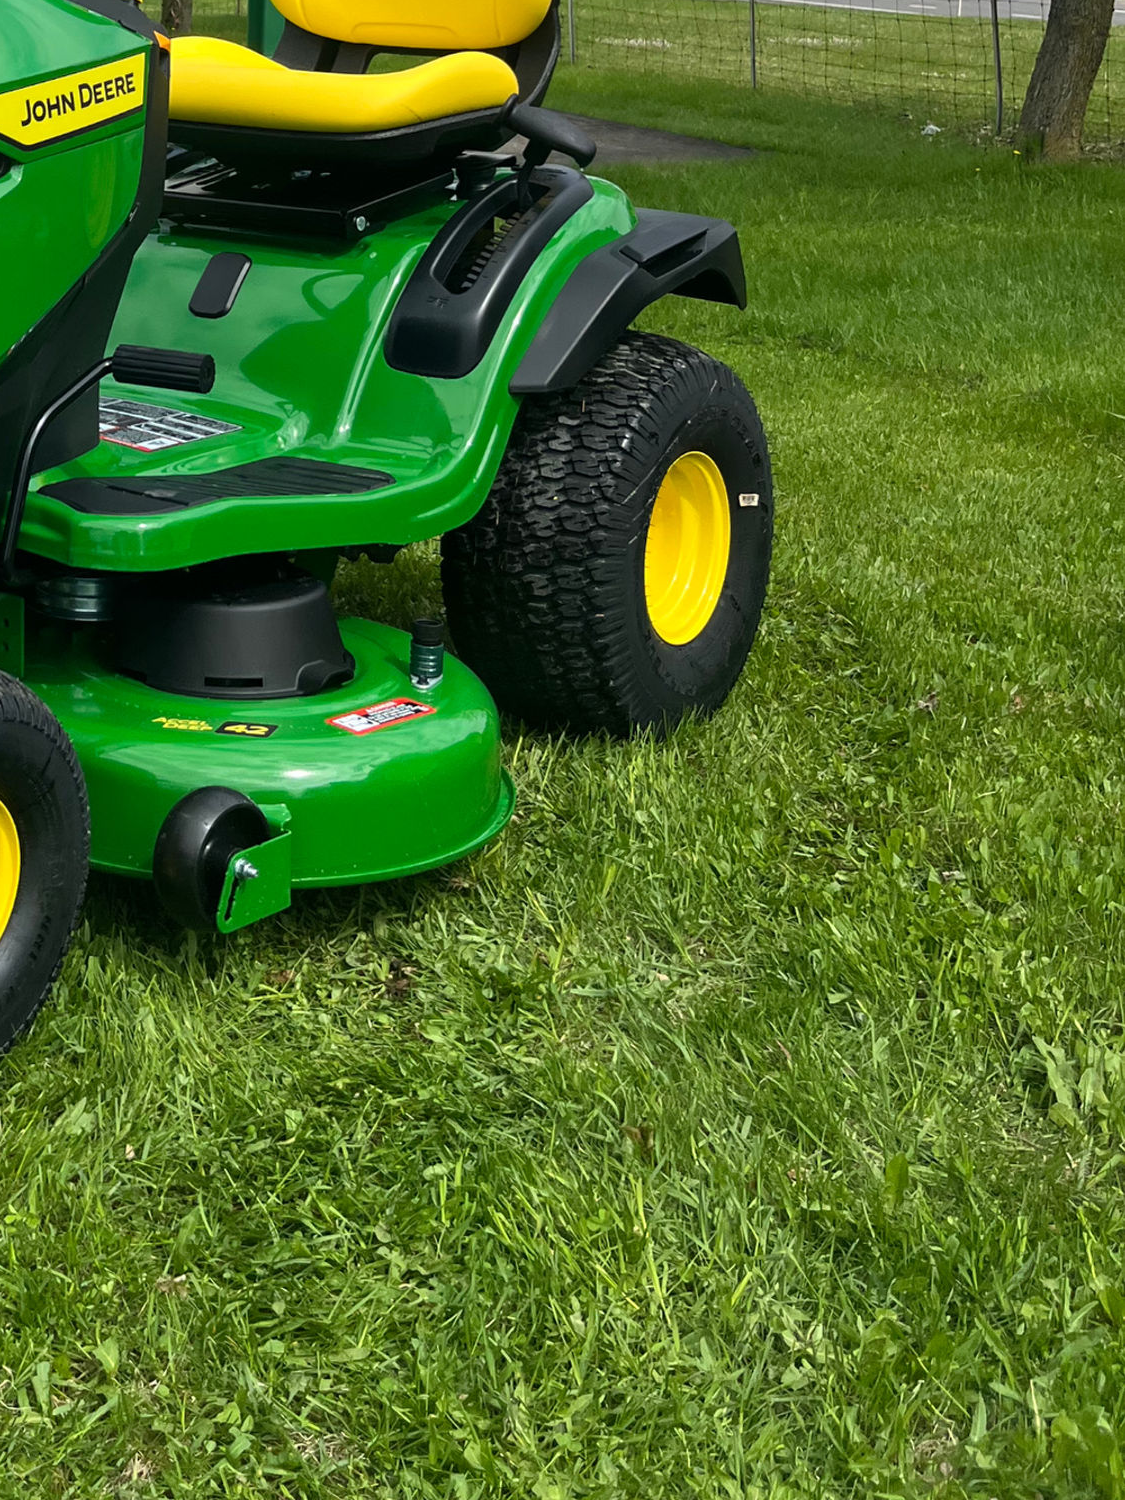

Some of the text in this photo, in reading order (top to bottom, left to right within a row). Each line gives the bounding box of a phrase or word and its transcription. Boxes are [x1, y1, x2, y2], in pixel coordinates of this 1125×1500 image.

[21, 72, 136, 127] JOHN DEERE
[162, 721, 213, 732] DEEP
[223, 724, 269, 736] 42
